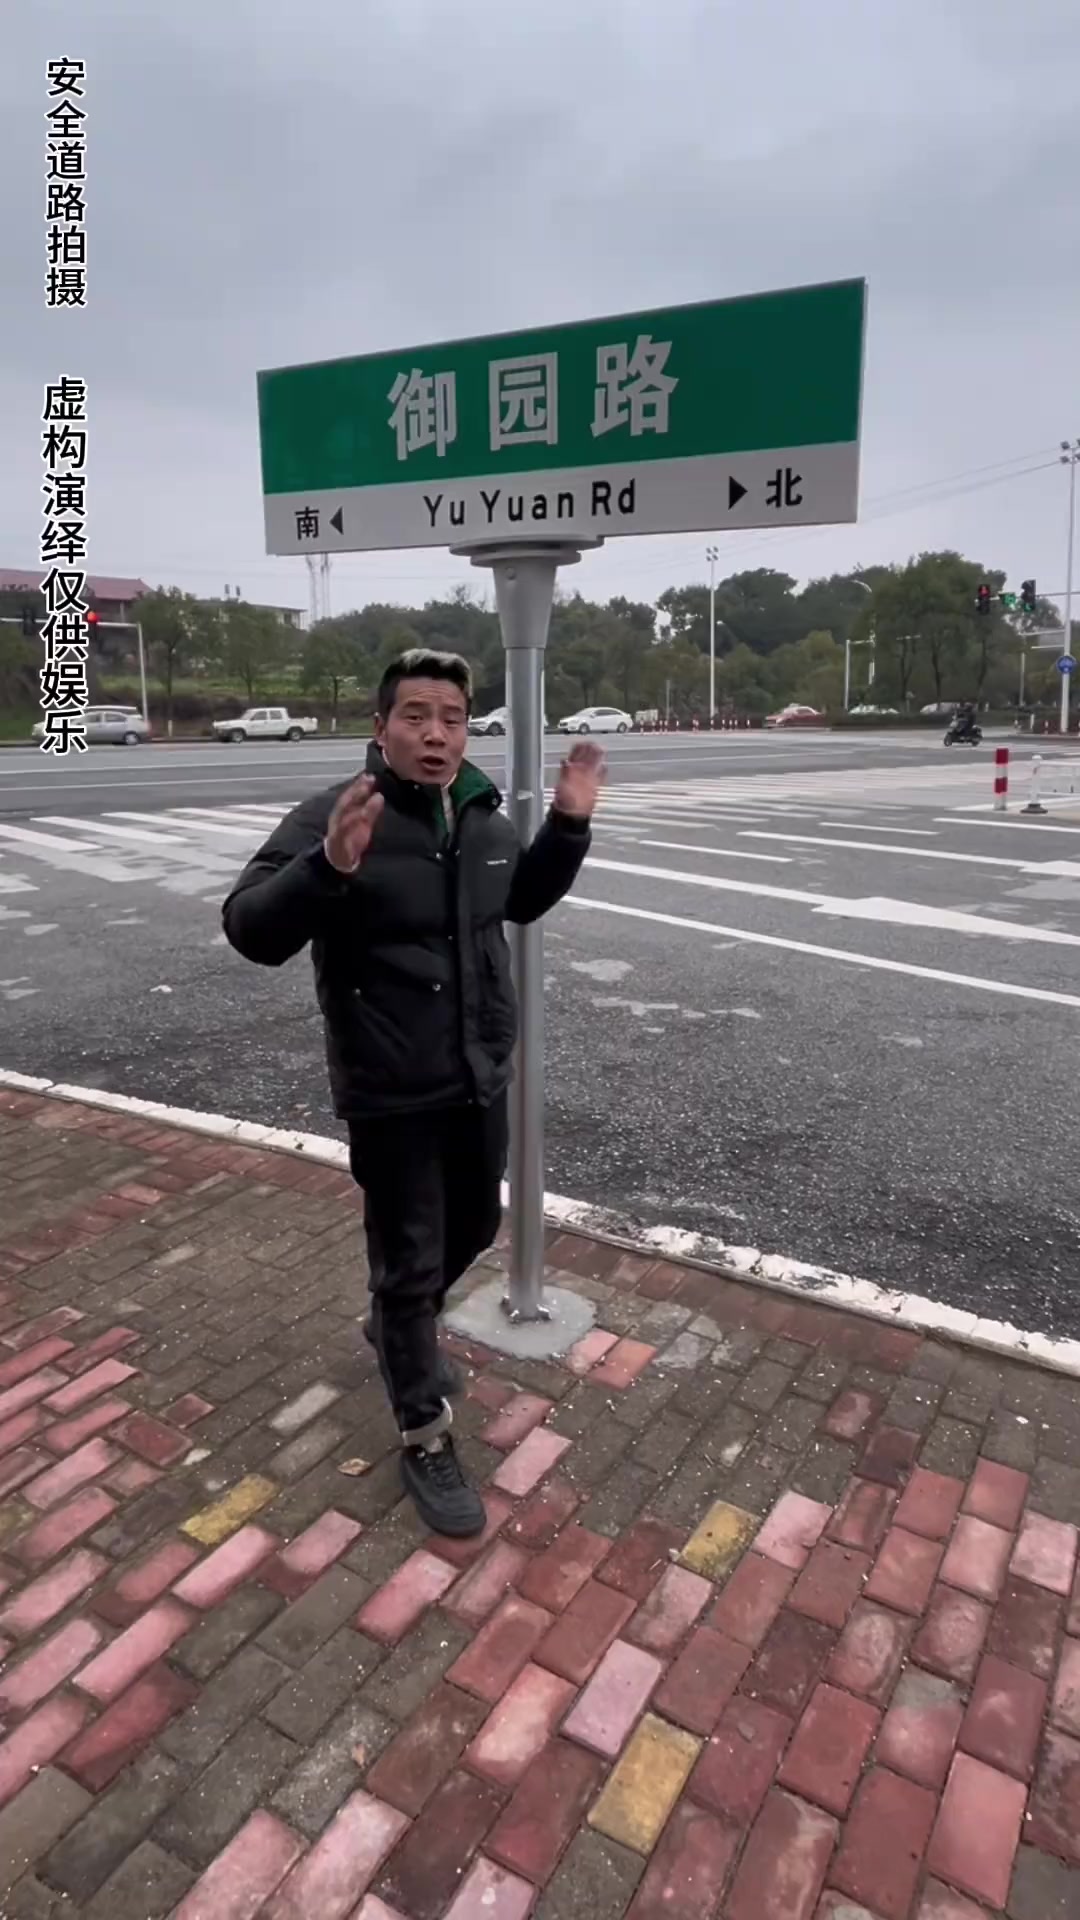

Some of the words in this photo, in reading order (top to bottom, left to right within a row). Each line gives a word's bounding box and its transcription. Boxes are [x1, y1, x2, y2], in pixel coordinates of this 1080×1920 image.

[386, 334, 679, 462] 御园路
[423, 493, 465, 528] Yu
[480, 488, 575, 524] Yuan
[590, 477, 636, 517] Rd
[764, 467, 804, 510] 北
[294, 506, 320, 541] 南
